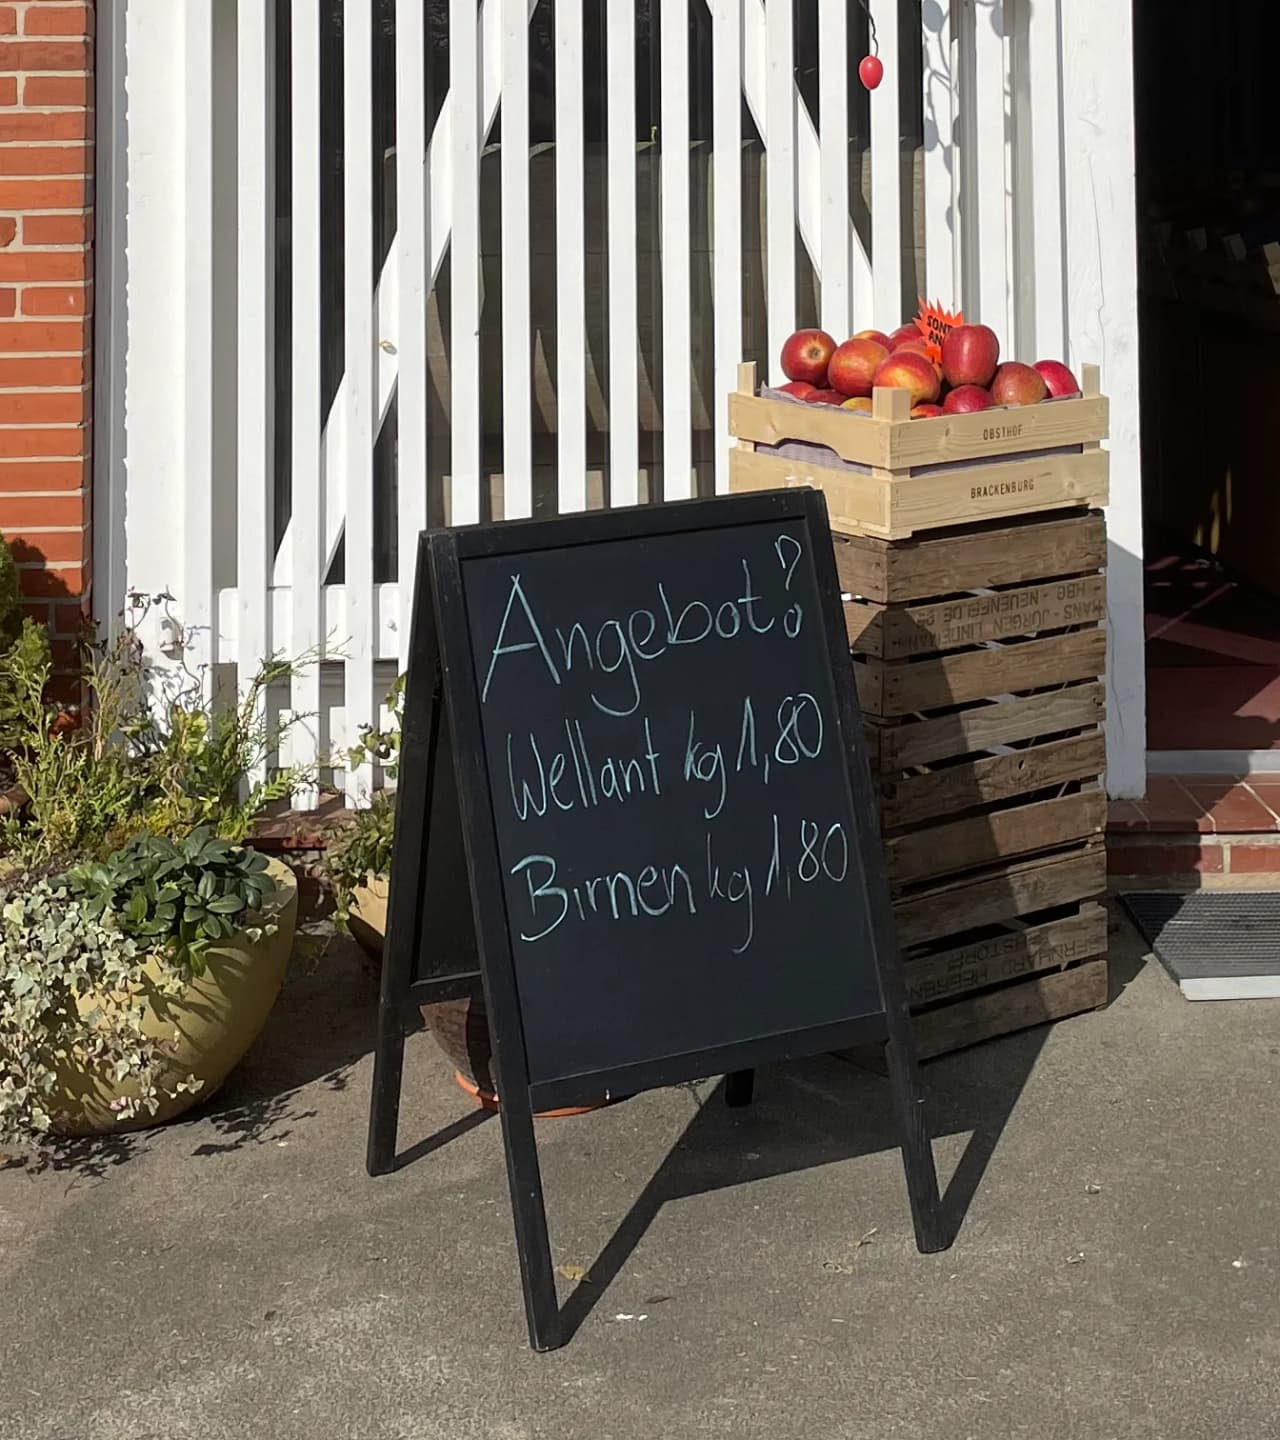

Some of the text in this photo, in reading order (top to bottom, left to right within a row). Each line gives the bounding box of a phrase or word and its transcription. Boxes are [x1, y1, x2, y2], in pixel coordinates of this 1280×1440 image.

[983, 424, 1023, 440] OBSTHOF
[970, 478, 1035, 499] BRACKENBURG
[506, 692, 824, 821] Wellant kg 1,80
[510, 813, 850, 954] Birnen kg 1,80
